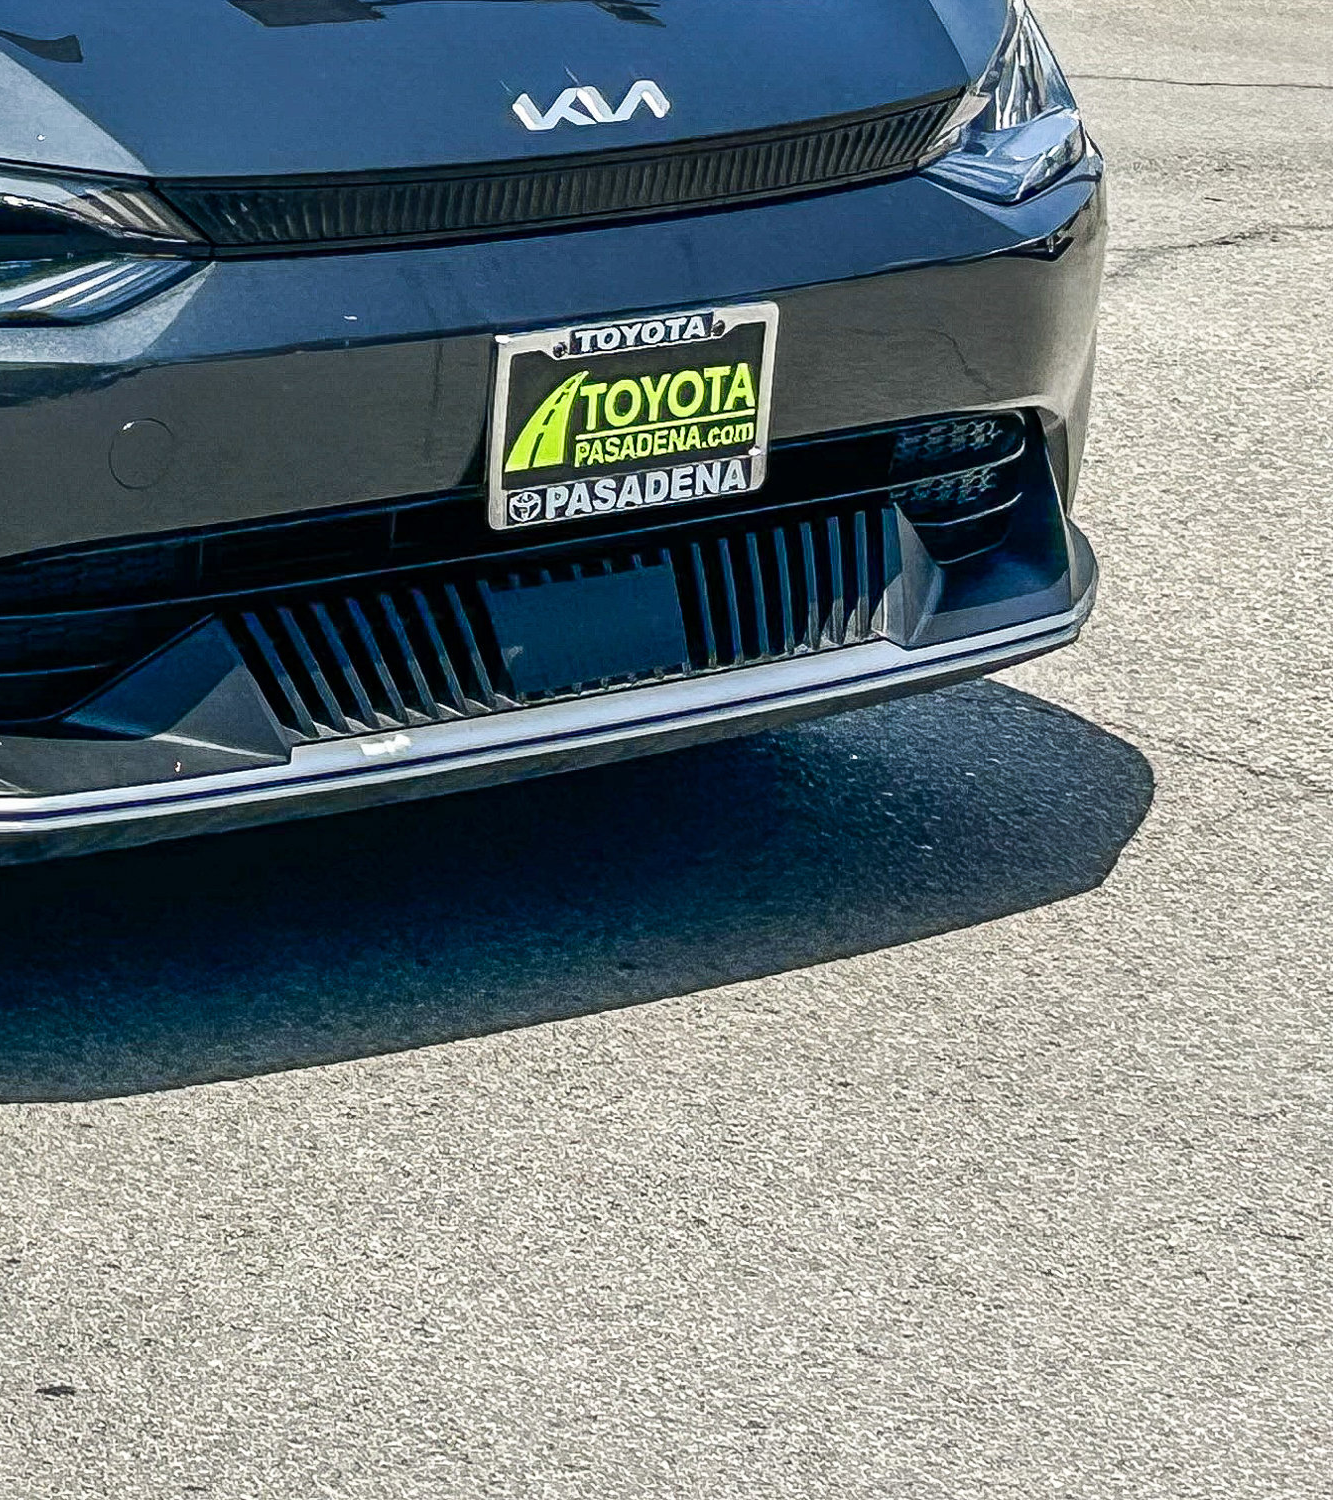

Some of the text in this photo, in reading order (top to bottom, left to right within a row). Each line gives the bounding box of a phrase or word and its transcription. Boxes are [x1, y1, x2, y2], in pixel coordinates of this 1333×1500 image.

[575, 316, 706, 352] TOYOTA
[579, 363, 755, 430] TOYOTA
[574, 422, 754, 468] PASADENA.com
[544, 460, 747, 519] PASADENA
